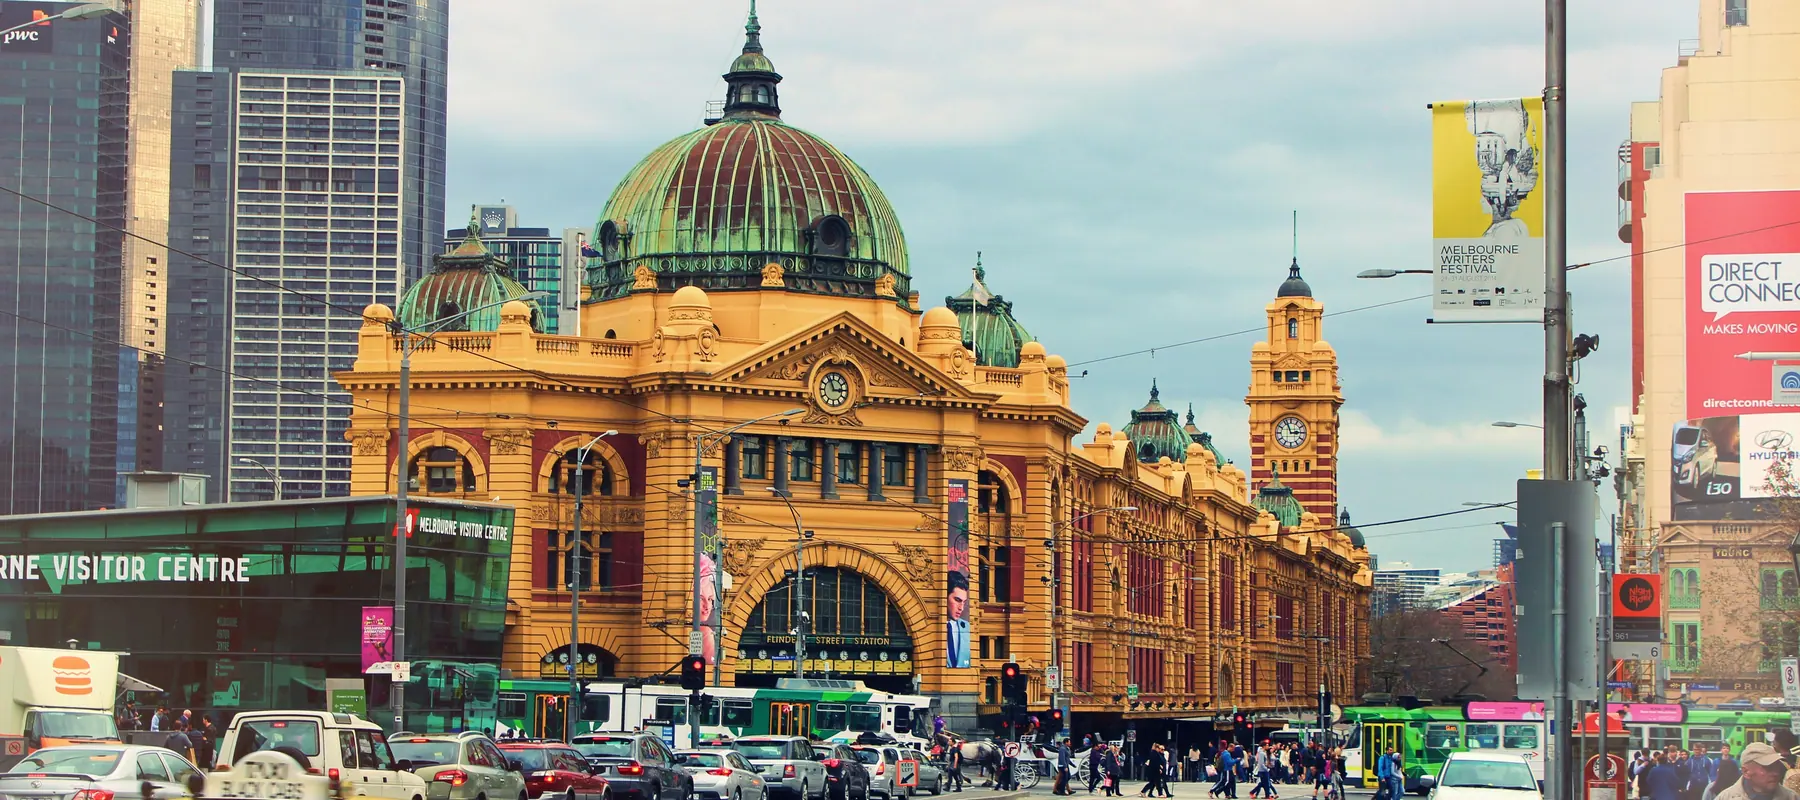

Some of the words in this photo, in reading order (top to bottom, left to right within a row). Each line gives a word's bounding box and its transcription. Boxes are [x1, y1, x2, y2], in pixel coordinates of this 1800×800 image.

[4, 30, 39, 43] pwc
[1440, 244, 1519, 254] MELBOURNE
[1440, 254, 1495, 264] WRITERS
[1440, 264, 1497, 274] FESTIVAL
[1709, 262, 1782, 281] DIRECT
[1703, 323, 1743, 335] MAKES
[1746, 323, 1798, 334] MOVING
[1706, 481, 1732, 495] i30
[419, 517, 457, 536] MELBOURNE
[460, 521, 483, 539] VISITOR
[485, 525, 508, 541] CENTRE
[53, 555, 146, 581] VISITOR
[158, 556, 250, 582] CENTRE
[767, 635, 797, 644] FLINDE
[816, 636, 846, 645] STREET
[854, 637, 890, 646] STATION
[1615, 632, 1629, 640] 961
[1651, 646, 1659, 658] 6
